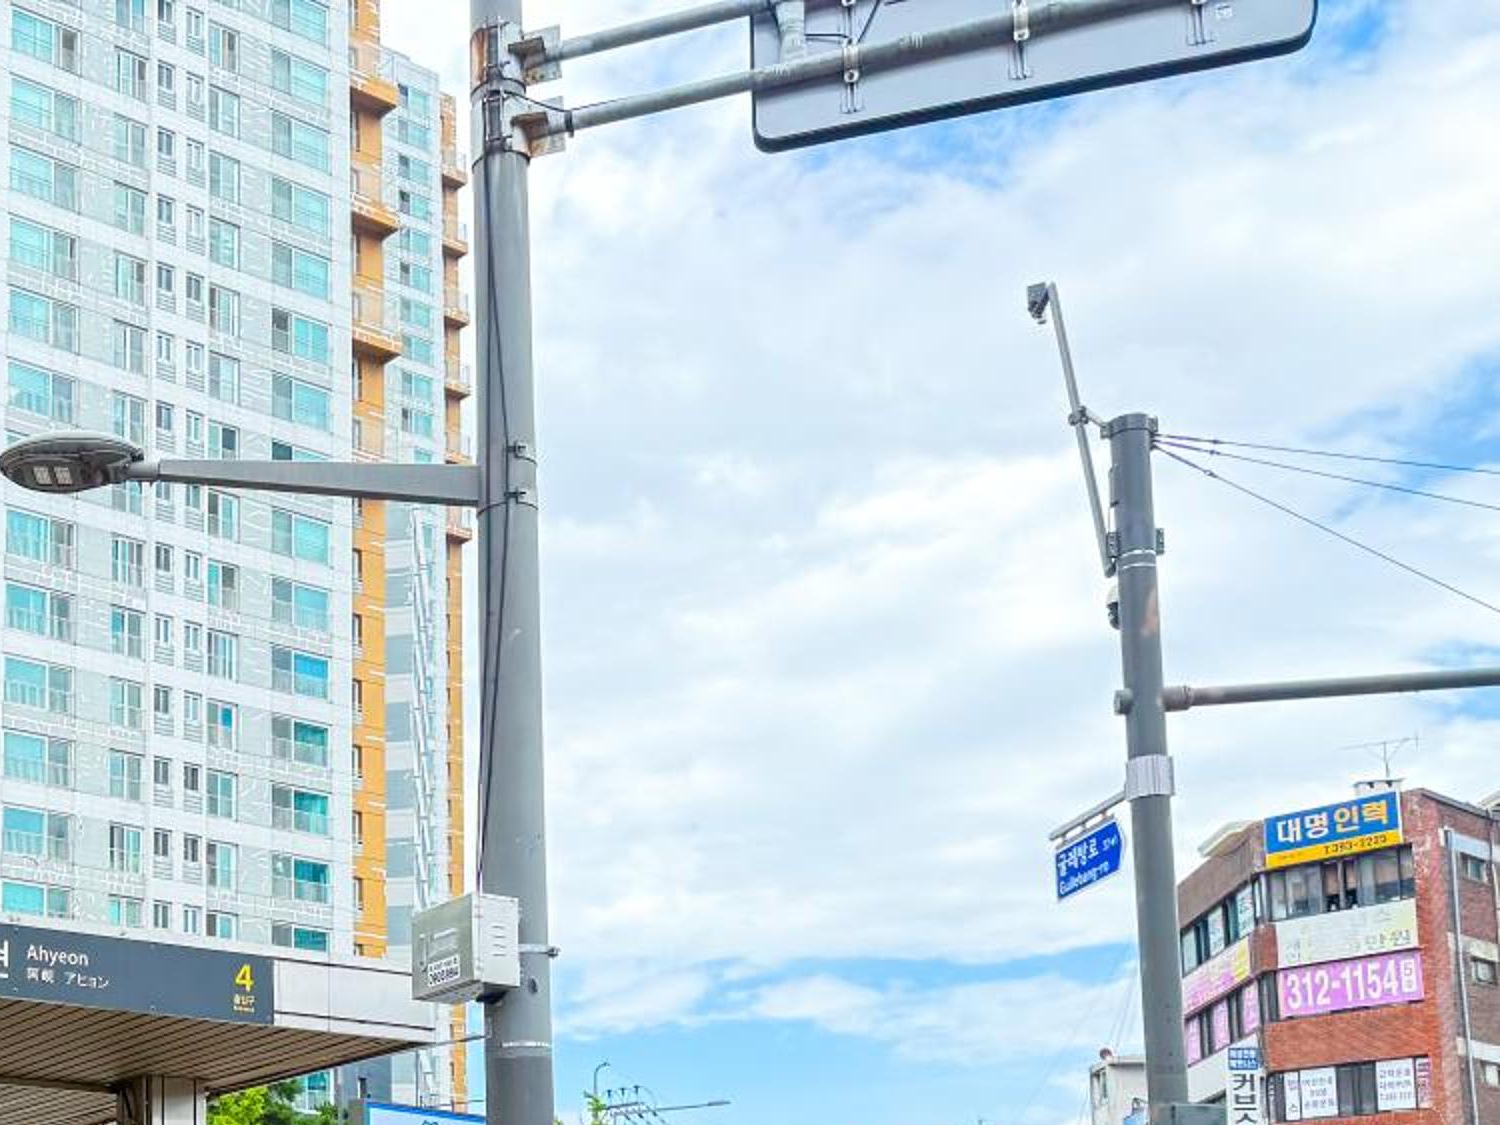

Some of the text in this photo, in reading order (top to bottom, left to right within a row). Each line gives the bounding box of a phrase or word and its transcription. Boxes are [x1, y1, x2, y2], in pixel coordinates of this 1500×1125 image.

[1276, 800, 1388, 842] 대명인력
[27, 944, 90, 967] Ahyeon
[235, 963, 254, 992] 4
[1286, 959, 1398, 1010] 312-1154
